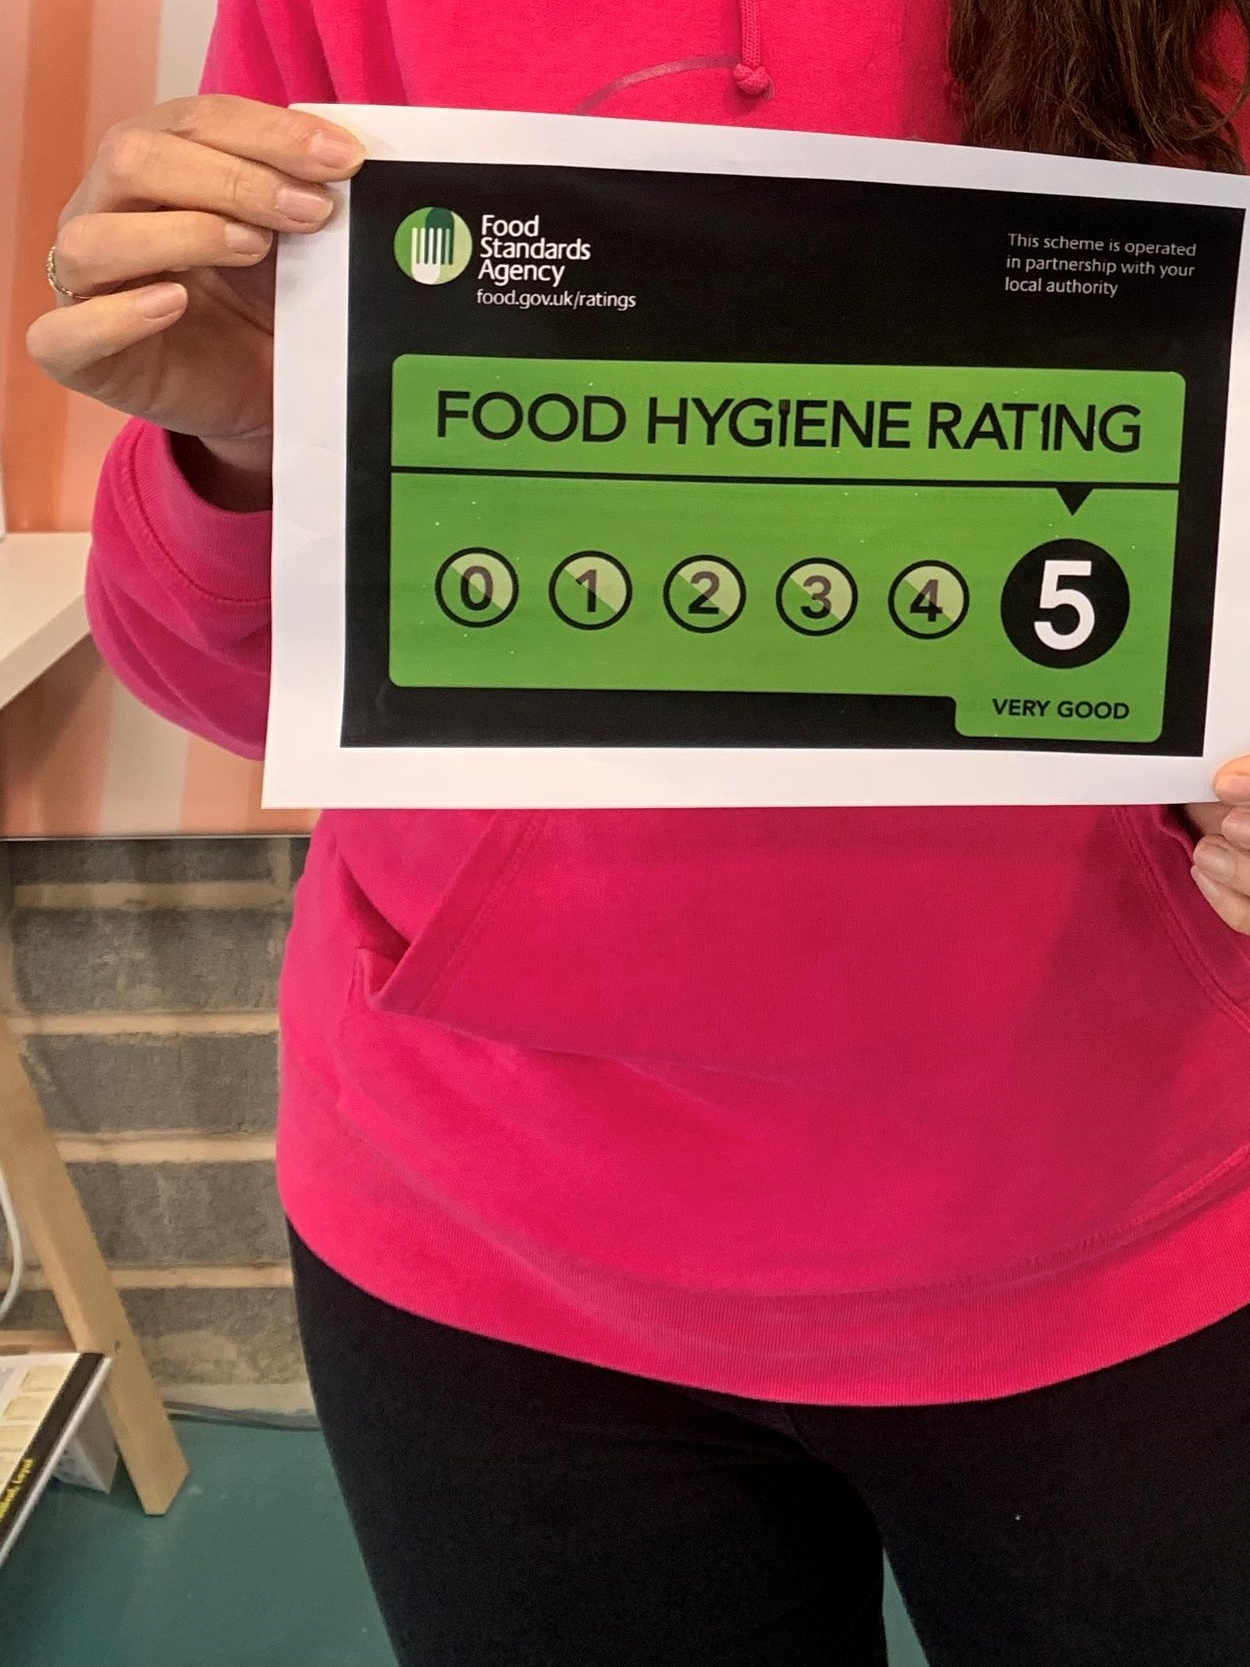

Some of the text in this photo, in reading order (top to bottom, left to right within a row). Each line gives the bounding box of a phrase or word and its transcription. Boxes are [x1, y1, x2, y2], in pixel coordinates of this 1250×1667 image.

[480, 214, 541, 238] Food
[478, 236, 592, 262] Standards
[1006, 232, 1197, 257] This scheme is operated
[477, 258, 567, 288] Agency
[1005, 254, 1196, 279] in partnership with your
[476, 288, 638, 312] food.gov.uk/ratings
[1004, 276, 1119, 299] local authority
[437, 390, 1142, 454] FOOD HYGIENE RATING
[458, 559, 1096, 651] 0 1 2 3 4 5
[991, 698, 1131, 721] VERY GOOD
